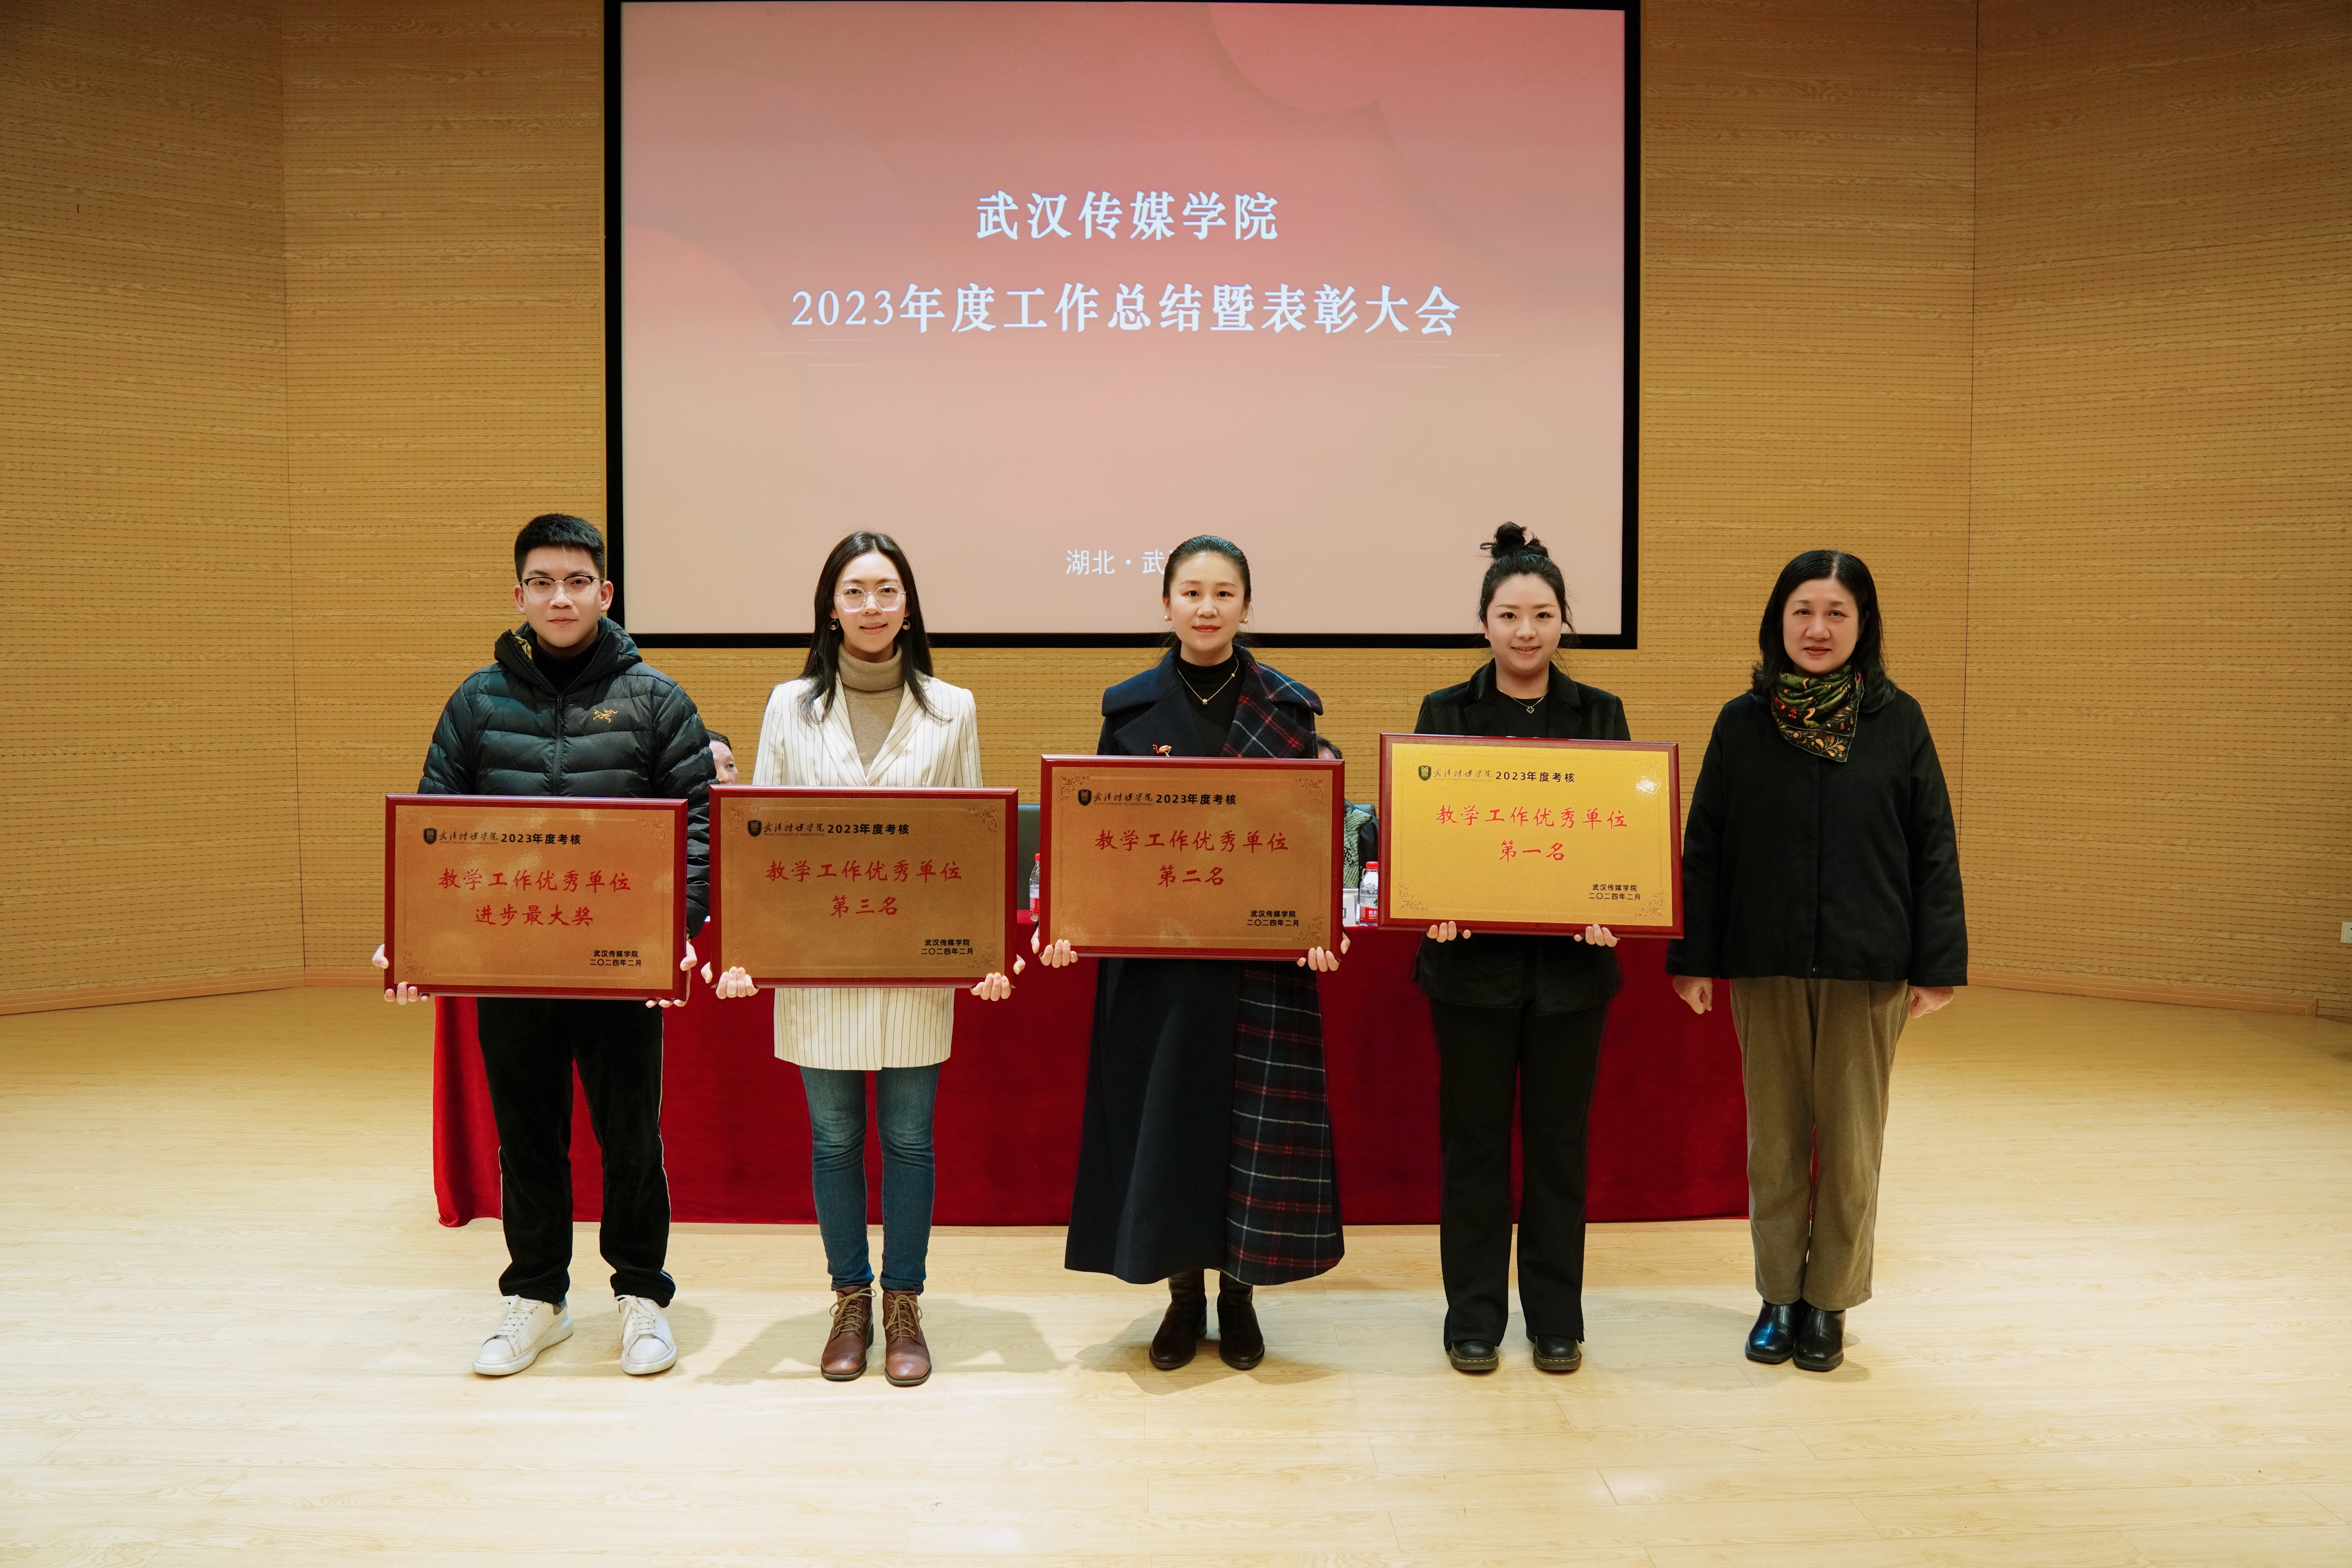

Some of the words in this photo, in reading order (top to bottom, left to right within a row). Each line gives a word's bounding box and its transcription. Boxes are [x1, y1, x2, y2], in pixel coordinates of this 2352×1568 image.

[976, 190, 1278, 241] 武汉传媒学院
[791, 282, 1460, 336] 2023年度工作总结暨表彰大会
[1066, 549, 1173, 575] 湖北·武
[1496, 771, 1574, 782] 2023年度考核
[1156, 794, 1236, 805] 2023年度考核
[1436, 805, 1627, 830] 教学工作优秀单位
[501, 834, 581, 845] 2023年度考核
[828, 824, 909, 835] 2023年度考核
[1095, 830, 1288, 853] 教学工作优秀单位
[1499, 840, 1565, 862] 第一名
[438, 868, 631, 894] 教学工作优秀单位
[766, 859, 962, 882] 教学工作优秀单位
[1158, 864, 1224, 888] 第二名
[475, 903, 593, 927] 进步最大奖
[830, 895, 898, 918] 第三名
